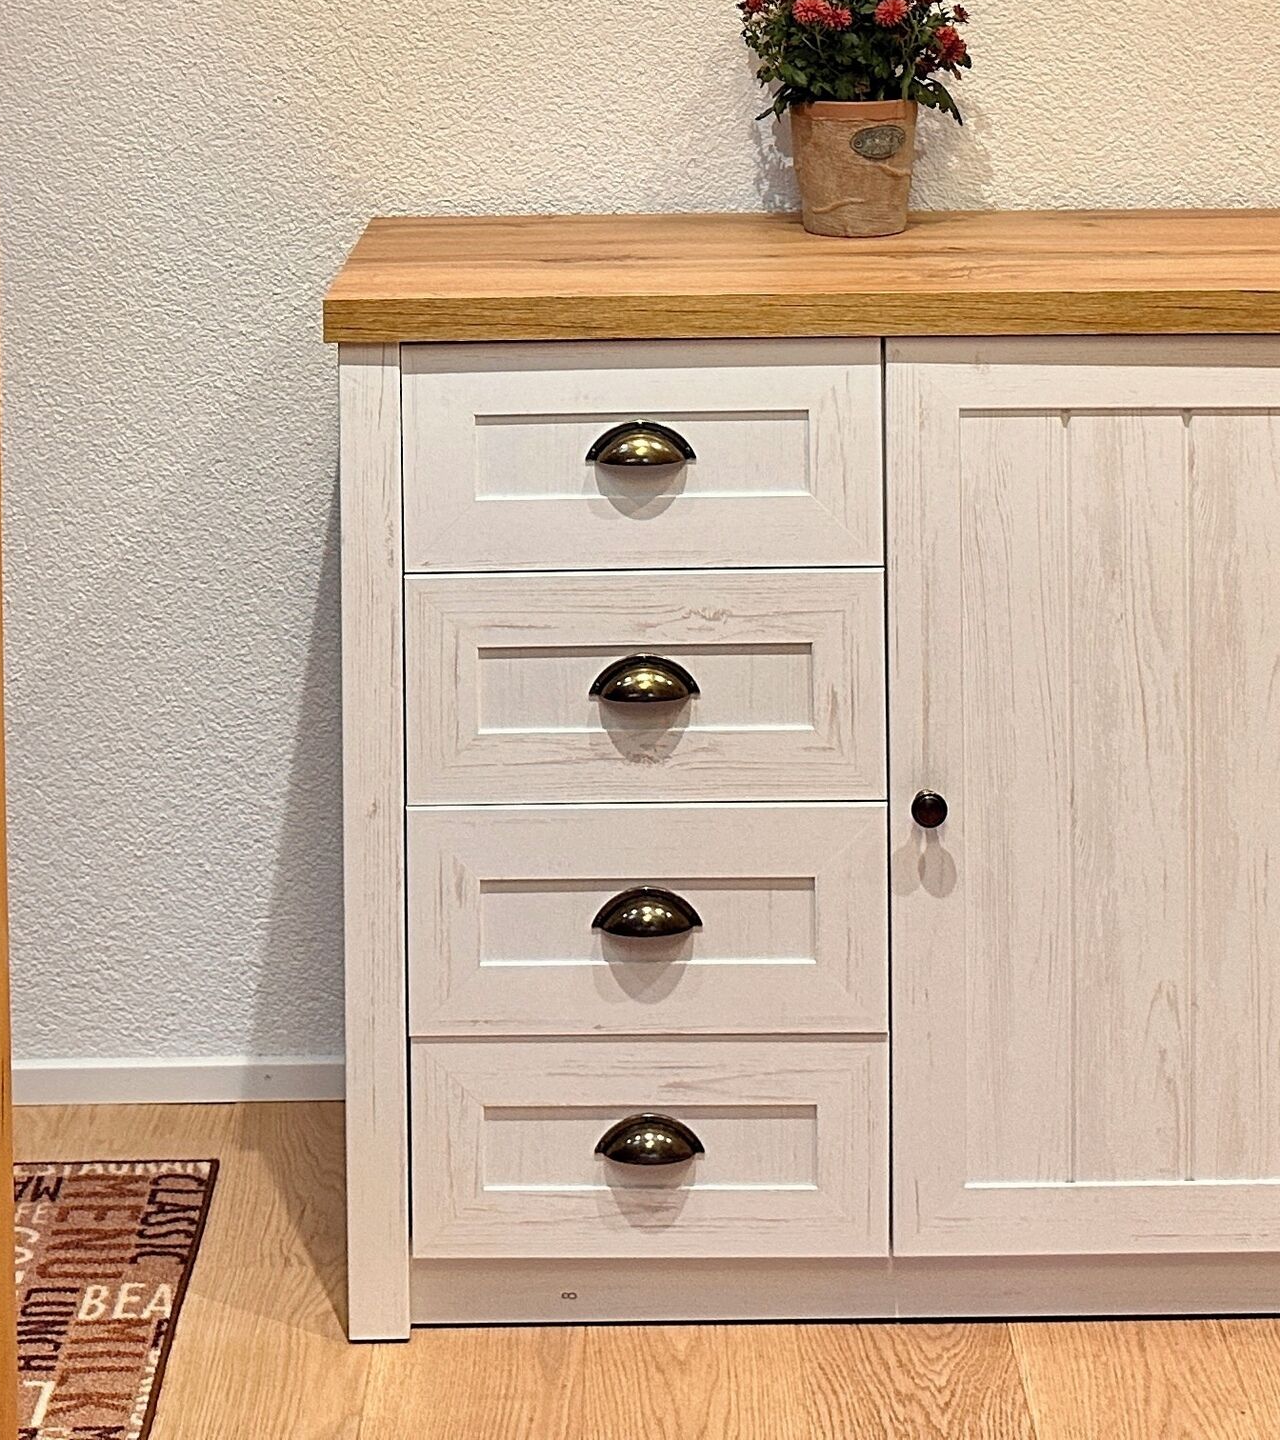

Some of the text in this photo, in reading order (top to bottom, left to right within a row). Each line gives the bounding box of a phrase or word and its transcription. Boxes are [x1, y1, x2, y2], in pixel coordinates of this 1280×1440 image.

[36, 1174, 152, 1278] MENU
[128, 1174, 207, 1264] CLASSIC
[46, 1317, 152, 1418] MILK
